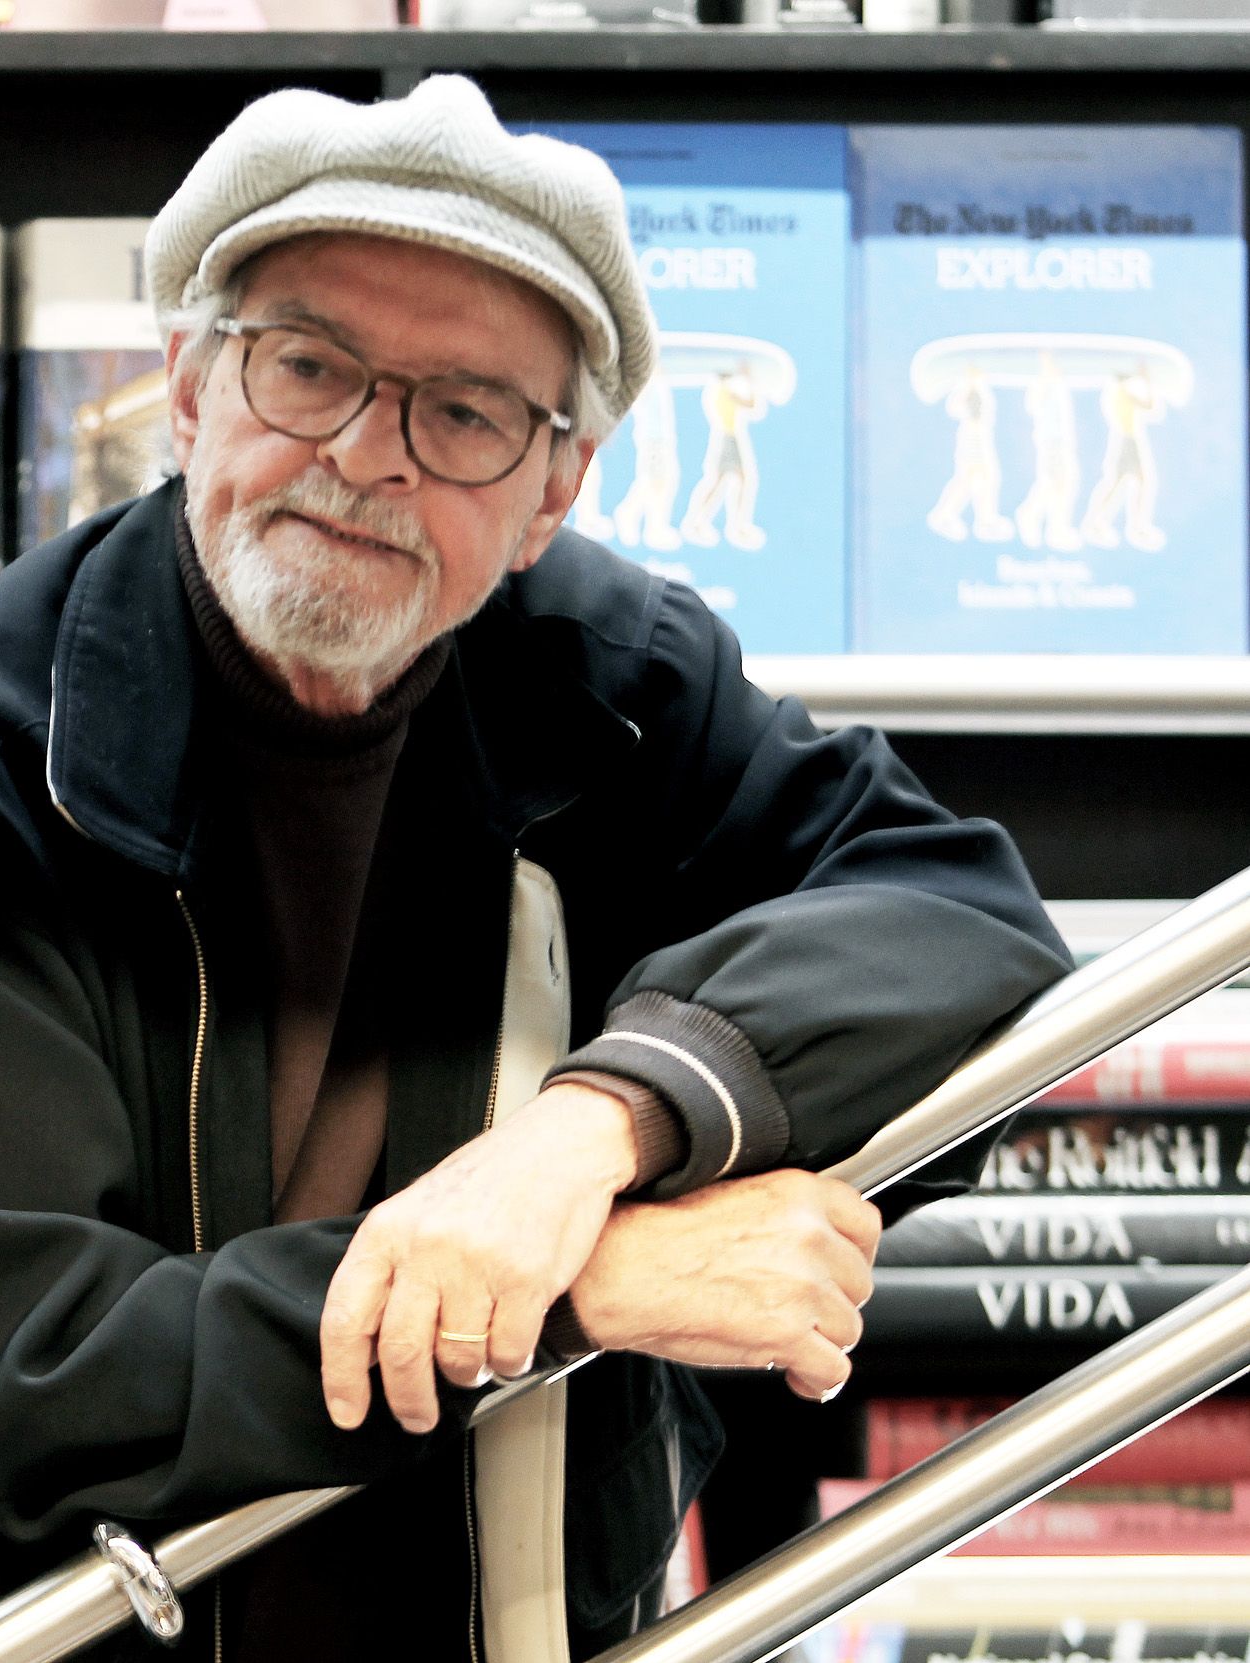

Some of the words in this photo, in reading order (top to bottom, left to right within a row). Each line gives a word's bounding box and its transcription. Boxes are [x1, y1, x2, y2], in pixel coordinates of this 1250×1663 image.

[707, 202, 798, 236] Times
[893, 202, 949, 236] The
[1023, 203, 1098, 241] York
[1104, 202, 1194, 236] Times
[638, 246, 758, 290] ORER
[936, 248, 1153, 289] EXPLORER
[975, 1214, 1133, 1260] VIDA
[975, 1277, 1135, 1330] VIDA
